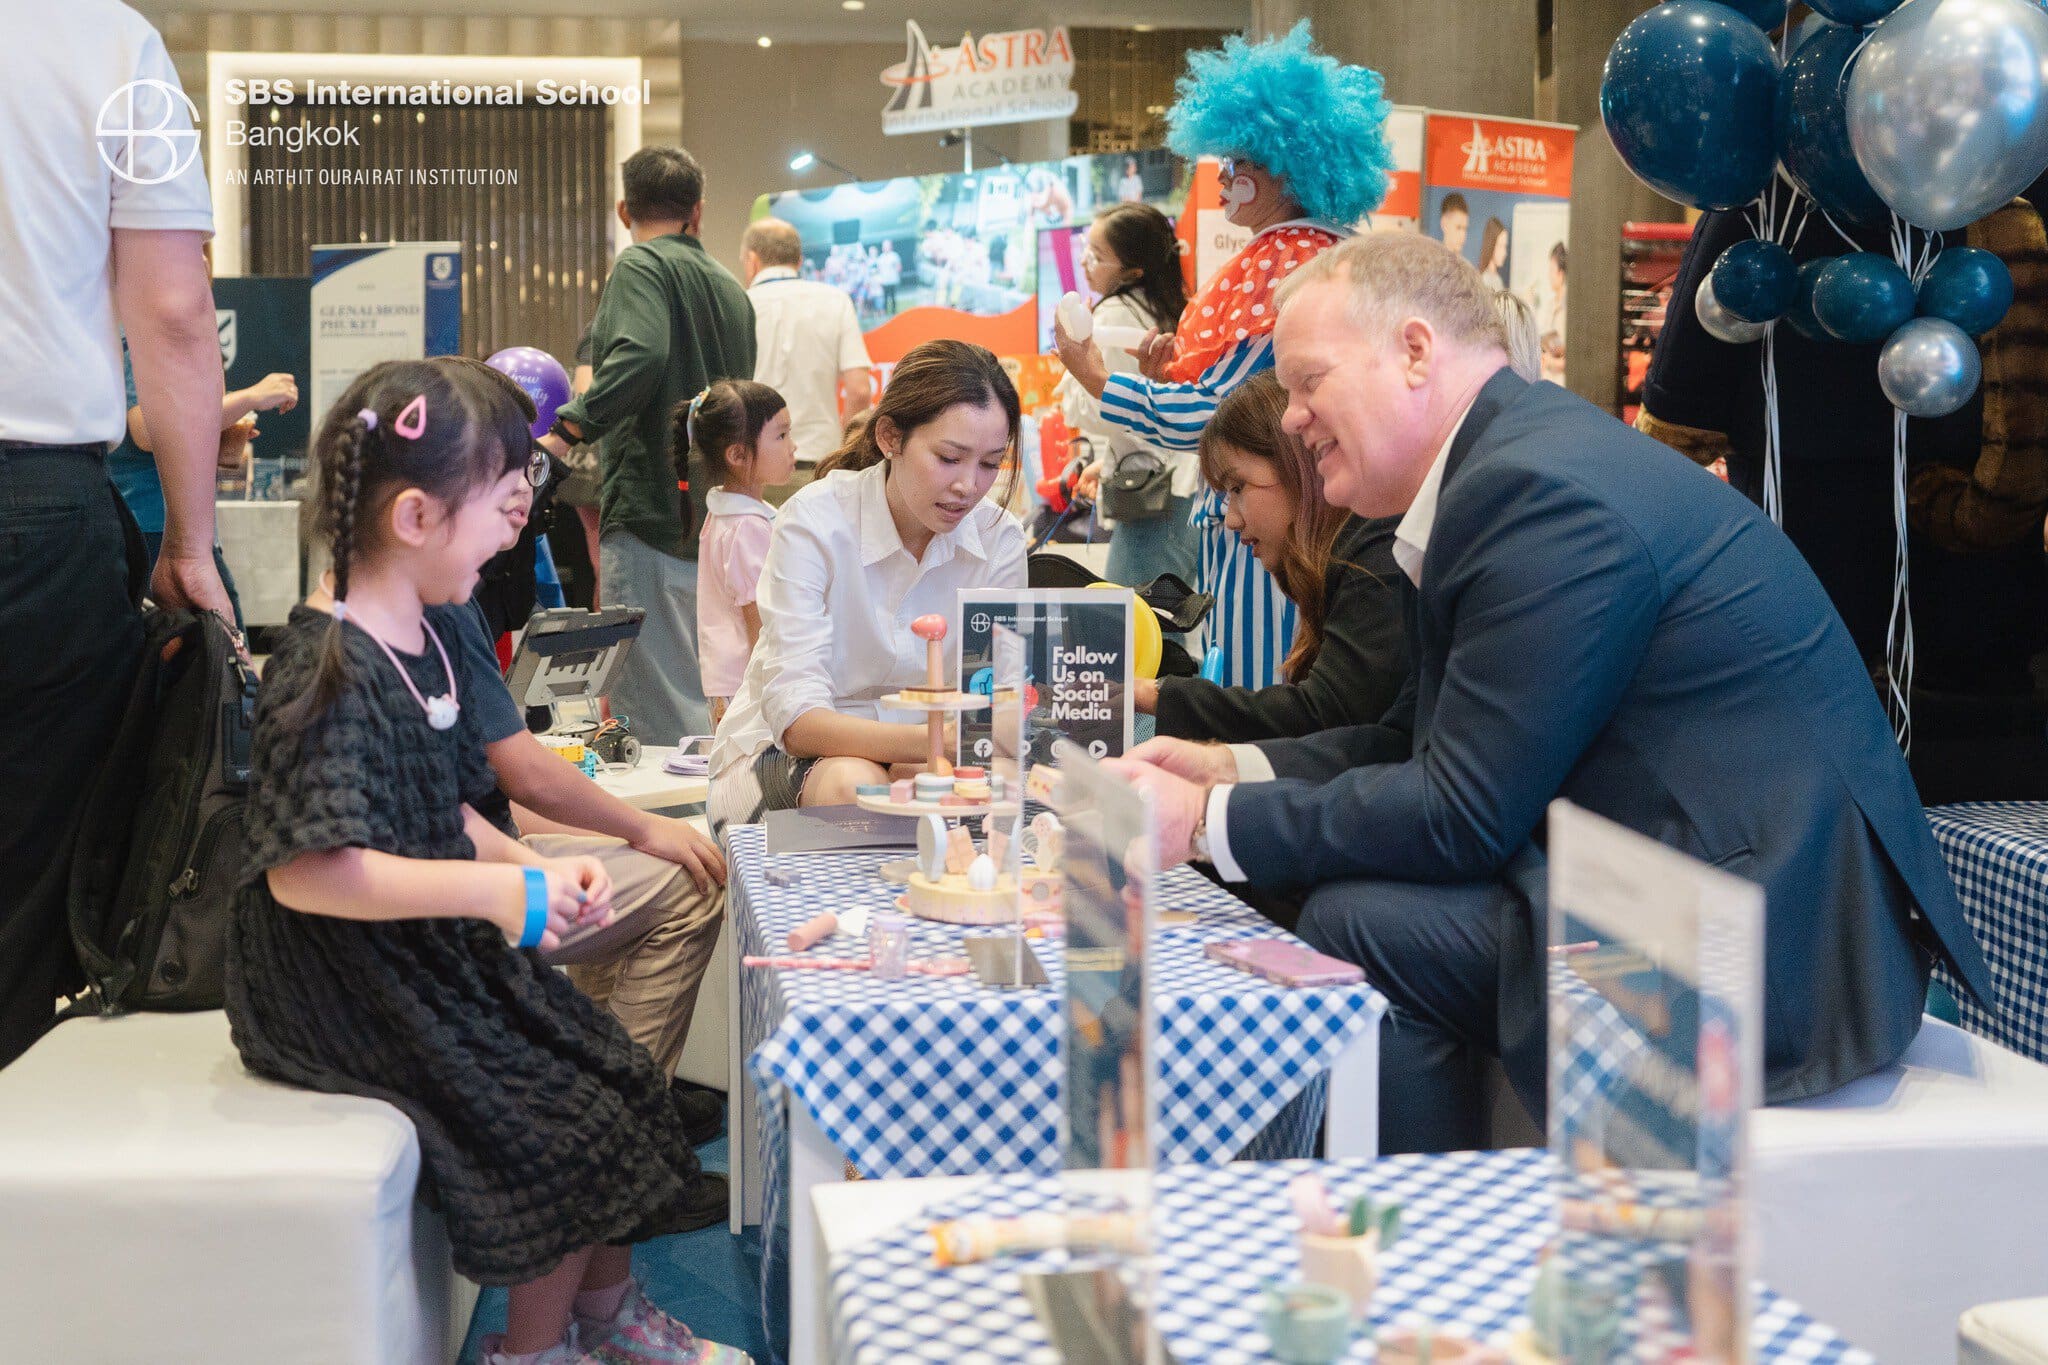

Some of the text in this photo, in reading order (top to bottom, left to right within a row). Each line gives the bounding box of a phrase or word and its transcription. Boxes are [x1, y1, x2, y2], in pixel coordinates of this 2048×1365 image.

[954, 29, 1071, 74] ASTRA
[952, 73, 1069, 99] ACADEMY
[1494, 135, 1548, 162] ASTRA
[1052, 646, 1118, 665] Follow
[1052, 665, 1105, 683] Us on
[1052, 683, 1109, 702] Social
[1051, 702, 1112, 721] Media
